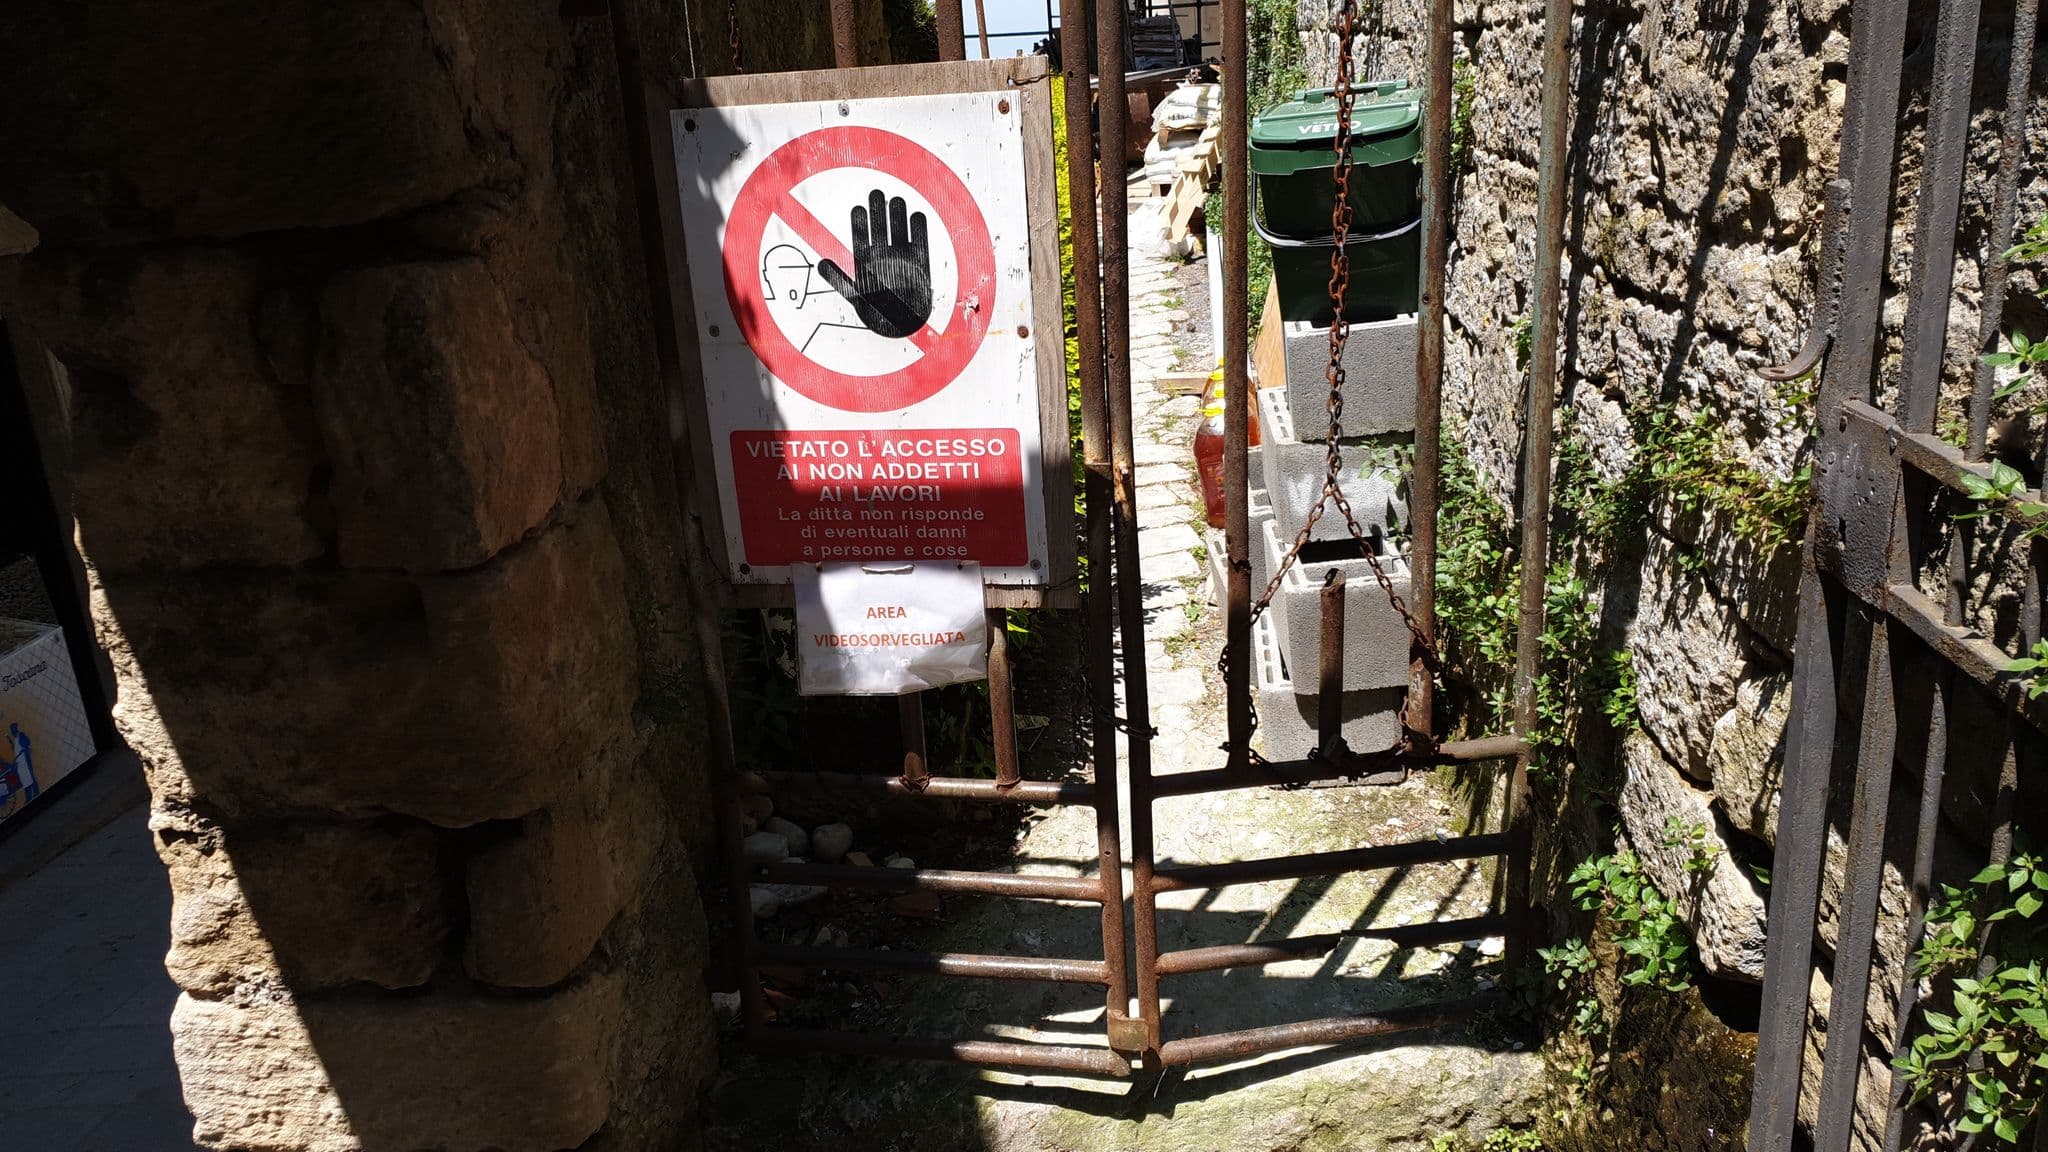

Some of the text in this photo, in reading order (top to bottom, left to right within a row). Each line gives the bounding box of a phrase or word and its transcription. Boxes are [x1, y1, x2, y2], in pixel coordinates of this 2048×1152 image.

[745, 438, 1006, 458] VIETATO L'ACCESSO
[777, 461, 980, 480] AI NON ADDETTI
[820, 485, 941, 503] AI LAVORI
[778, 507, 984, 524] La ditta non risponde
[801, 525, 967, 538] di eventuali danni
[803, 545, 968, 559] a persone e cose
[866, 606, 907, 619] AREA
[814, 631, 966, 648] VIDEOSORVEGLIATA
